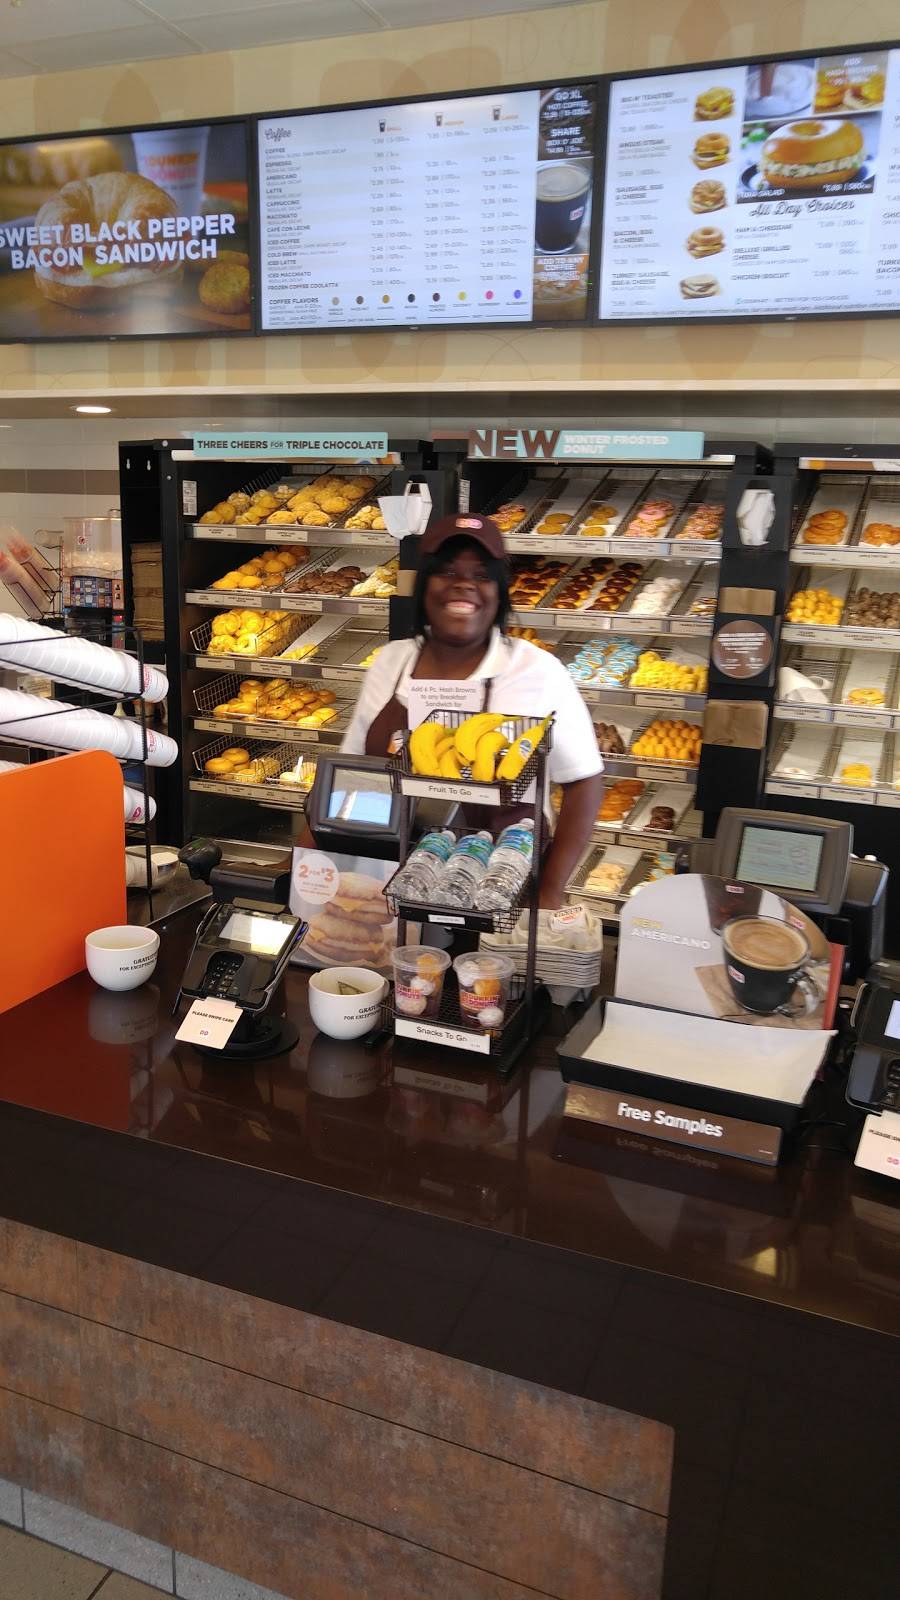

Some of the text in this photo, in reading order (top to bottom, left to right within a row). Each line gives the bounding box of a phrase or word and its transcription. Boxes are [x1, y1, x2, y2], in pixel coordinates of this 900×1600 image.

[264, 127, 292, 142] Coffee
[749, 203, 770, 218] All
[0, 213, 236, 248] SWEET BLACK PEPPER
[11, 238, 218, 270] BACON SANDWICH
[269, 298, 291, 306] COFFEE
[198, 440, 228, 449] THREE
[230, 440, 268, 449] CHEERS
[286, 440, 321, 450] TRIPLE
[322, 440, 385, 450] CHOCOLATE
[471, 429, 561, 458] NEW
[563, 434, 670, 445] WINTER FROSTED
[563, 444, 608, 455] DONUT
[428, 785, 472, 796] Fruit To Go
[298, 864, 309, 878] 2
[631, 927, 712, 950] AMERICANO
[192, 1010, 208, 1018] PLEASE
[416, 1026, 468, 1042] Snacks To Go
[616, 1101, 724, 1138] Free Samples
